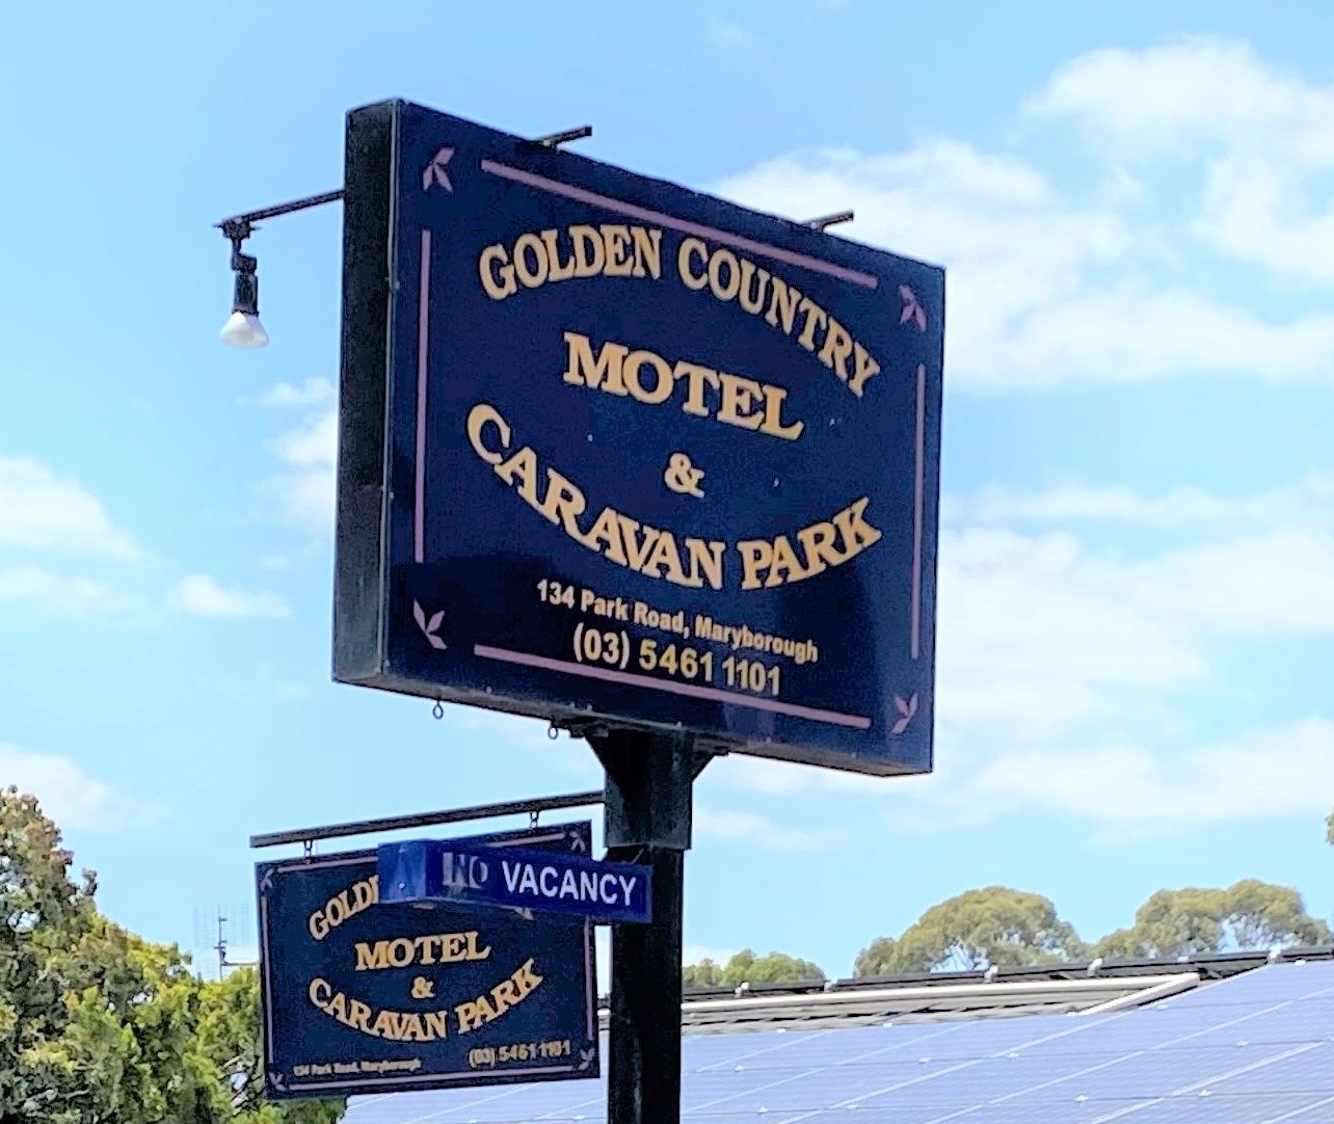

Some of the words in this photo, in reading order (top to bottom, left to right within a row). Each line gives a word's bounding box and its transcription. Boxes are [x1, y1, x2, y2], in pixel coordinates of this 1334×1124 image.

[478, 223, 663, 300] GOLDEN
[677, 236, 880, 398] COUNTRY
[563, 331, 805, 440] MOTEL
[467, 403, 723, 590] CARAVAN
[740, 497, 882, 590] PARK
[665, 452, 705, 498] &
[537, 578, 575, 608] 134
[581, 589, 628, 621] Park
[633, 602, 689, 639] Road,
[695, 614, 818, 665] Maryborough
[572, 622, 630, 670] (03)
[638, 638, 713, 682] 5461
[722, 655, 780, 696] 1101
[308, 874, 380, 941] GOLD
[502, 860, 637, 906] VACANCY
[354, 931, 491, 971] MOTEL
[308, 977, 447, 1042] CARAVAN
[456, 958, 544, 1035] PARK
[410, 976, 436, 999] &
[498, 1043, 536, 1062] 5461
